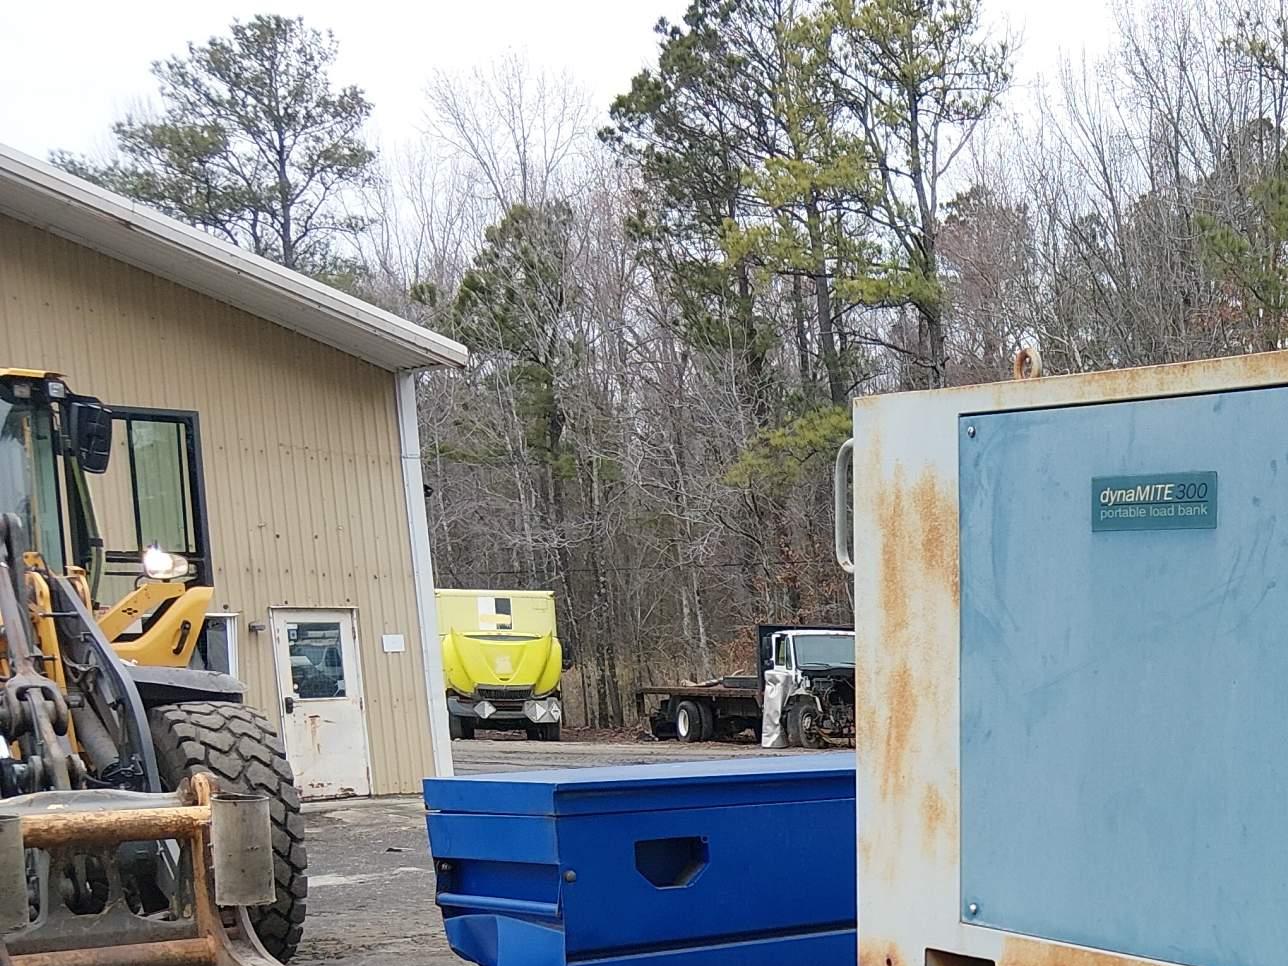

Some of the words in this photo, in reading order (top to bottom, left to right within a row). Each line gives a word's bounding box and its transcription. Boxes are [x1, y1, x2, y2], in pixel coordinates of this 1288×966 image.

[1100, 483, 1175, 506] dynaMITE
[1175, 482, 1208, 500] 300
[1100, 506, 1147, 520] portable
[1149, 504, 1175, 517] load
[1178, 503, 1208, 516] bank
